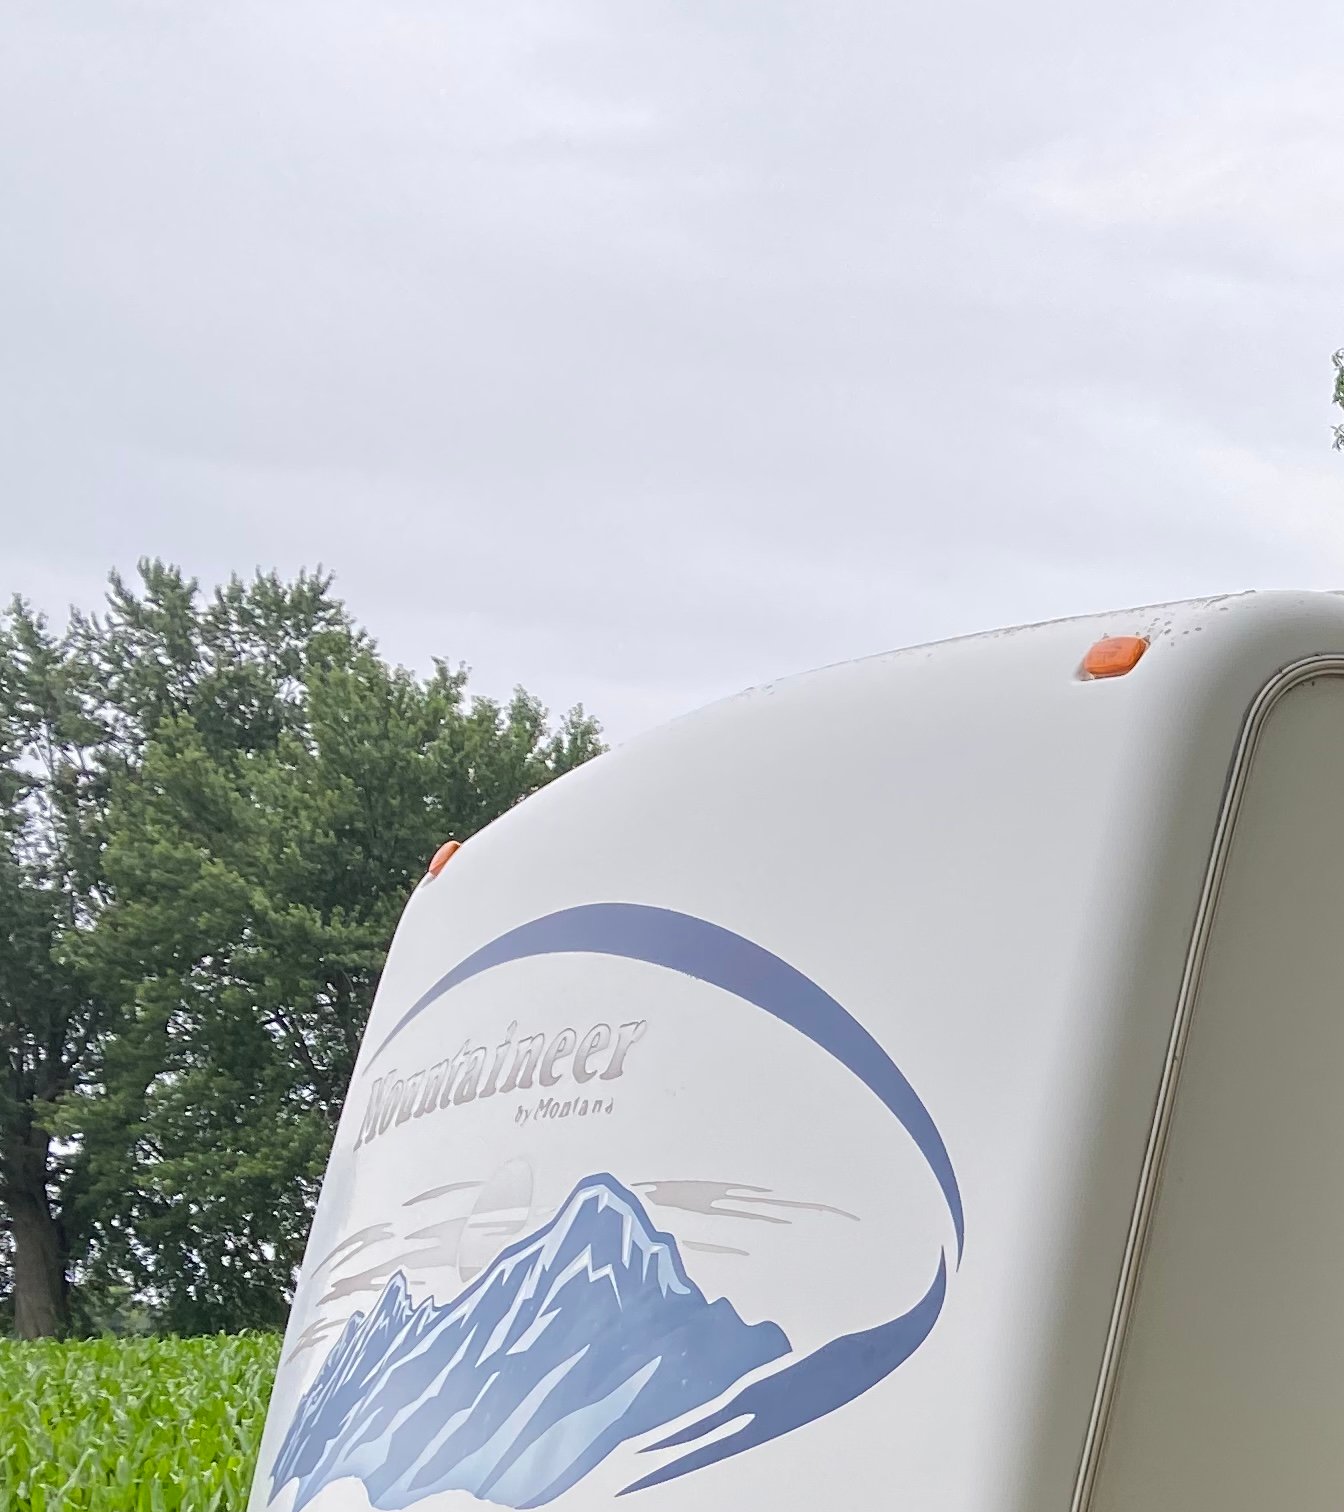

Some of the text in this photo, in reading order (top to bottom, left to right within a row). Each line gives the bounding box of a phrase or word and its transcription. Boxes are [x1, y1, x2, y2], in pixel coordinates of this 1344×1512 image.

[353, 1020, 648, 1152] Mountaineer
[514, 1096, 614, 1127] by Montana
